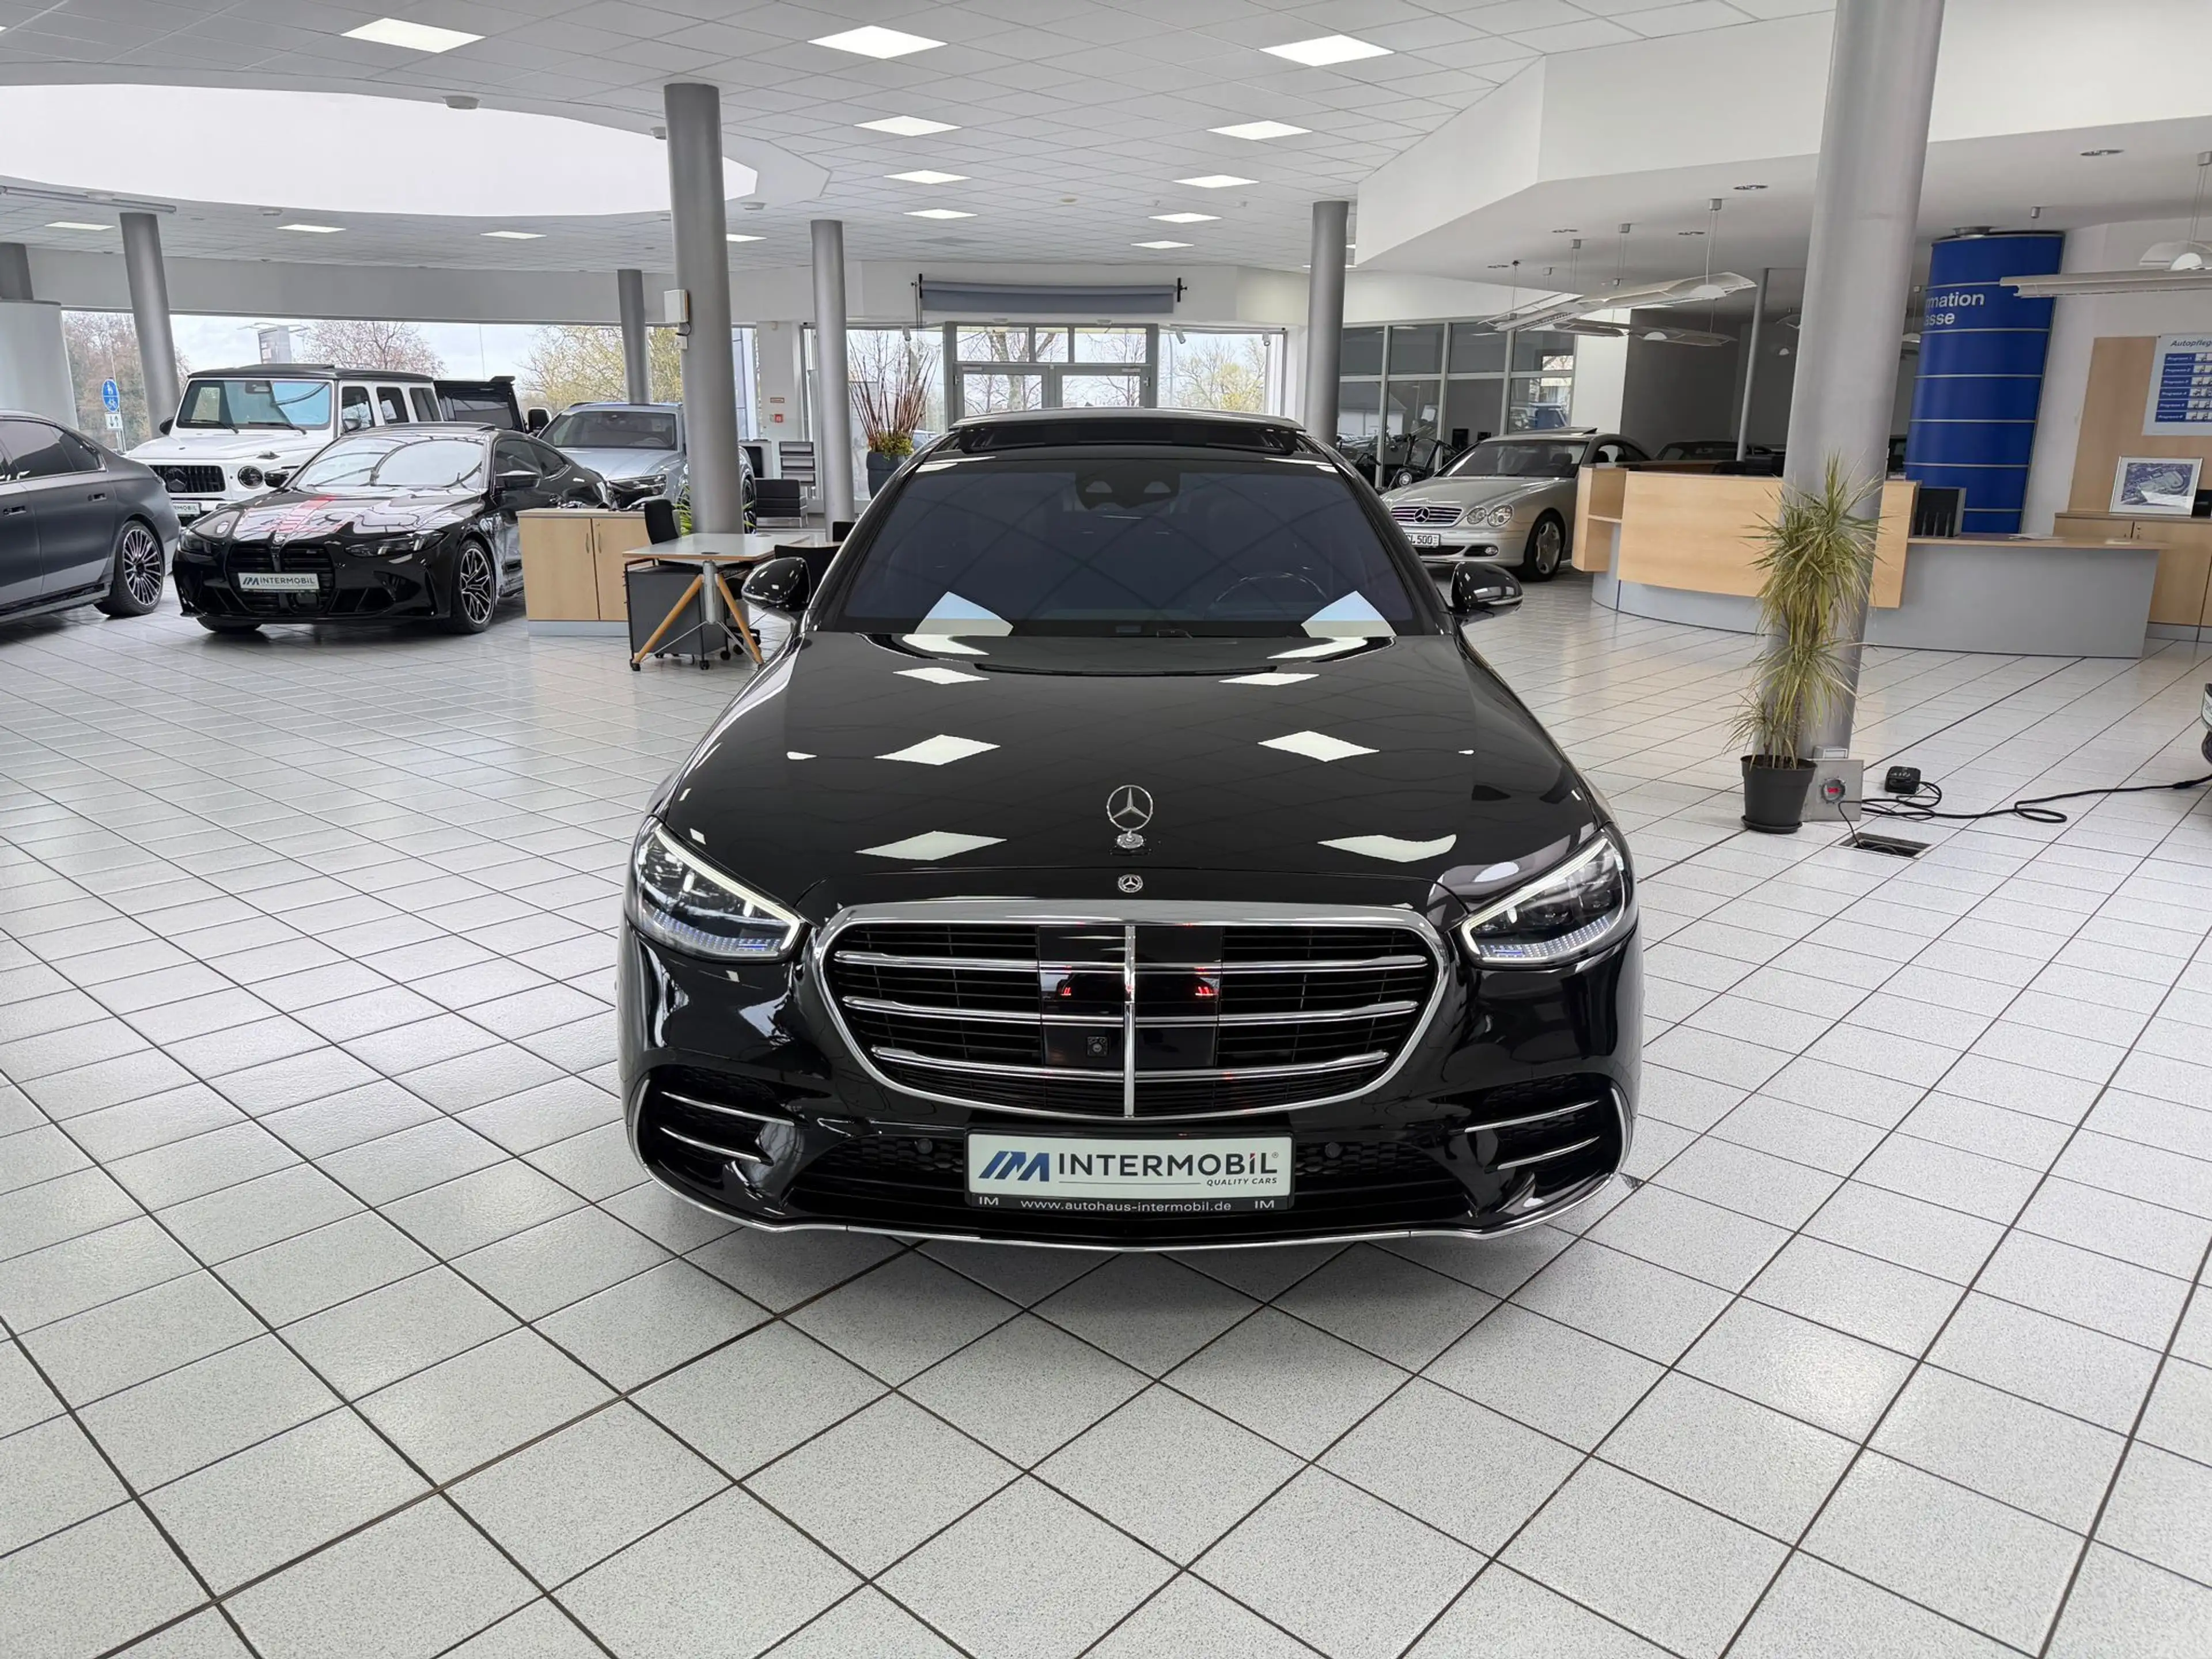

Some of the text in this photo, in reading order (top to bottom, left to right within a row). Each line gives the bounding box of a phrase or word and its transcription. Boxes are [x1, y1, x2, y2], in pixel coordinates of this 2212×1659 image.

[1417, 535, 1433, 544] 500
[1206, 1178, 1249, 1187] QUALITY
[979, 1196, 1275, 1212] IM www.autohaus-intermobil.de IM
